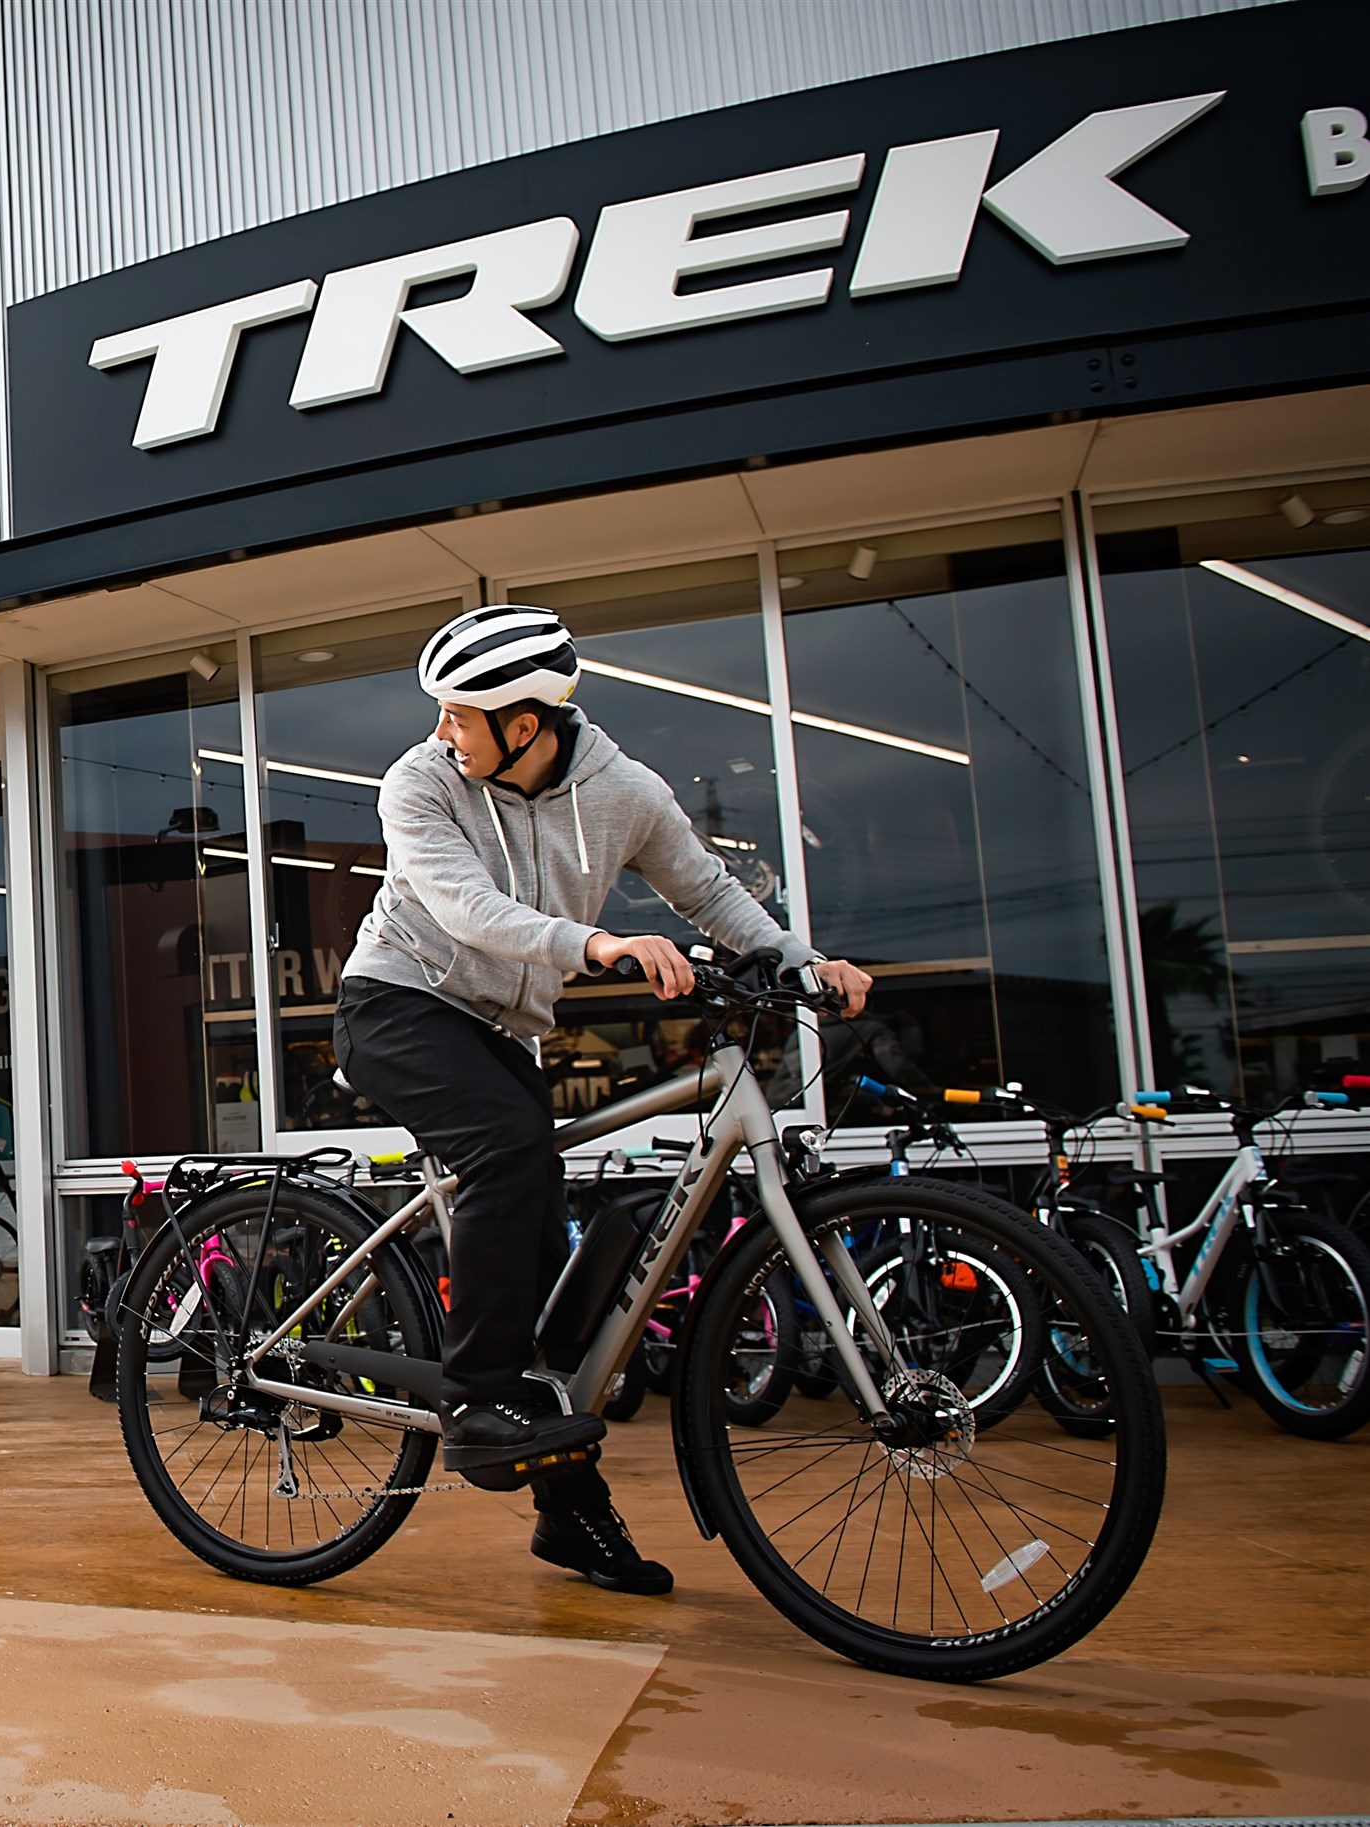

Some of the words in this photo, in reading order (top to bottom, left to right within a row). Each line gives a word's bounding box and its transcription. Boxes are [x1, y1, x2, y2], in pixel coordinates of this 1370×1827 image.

[88, 90, 1227, 450] TREK
[609, 1161, 703, 1316] TREK
[930, 1556, 1093, 1648] BONTRAGER
